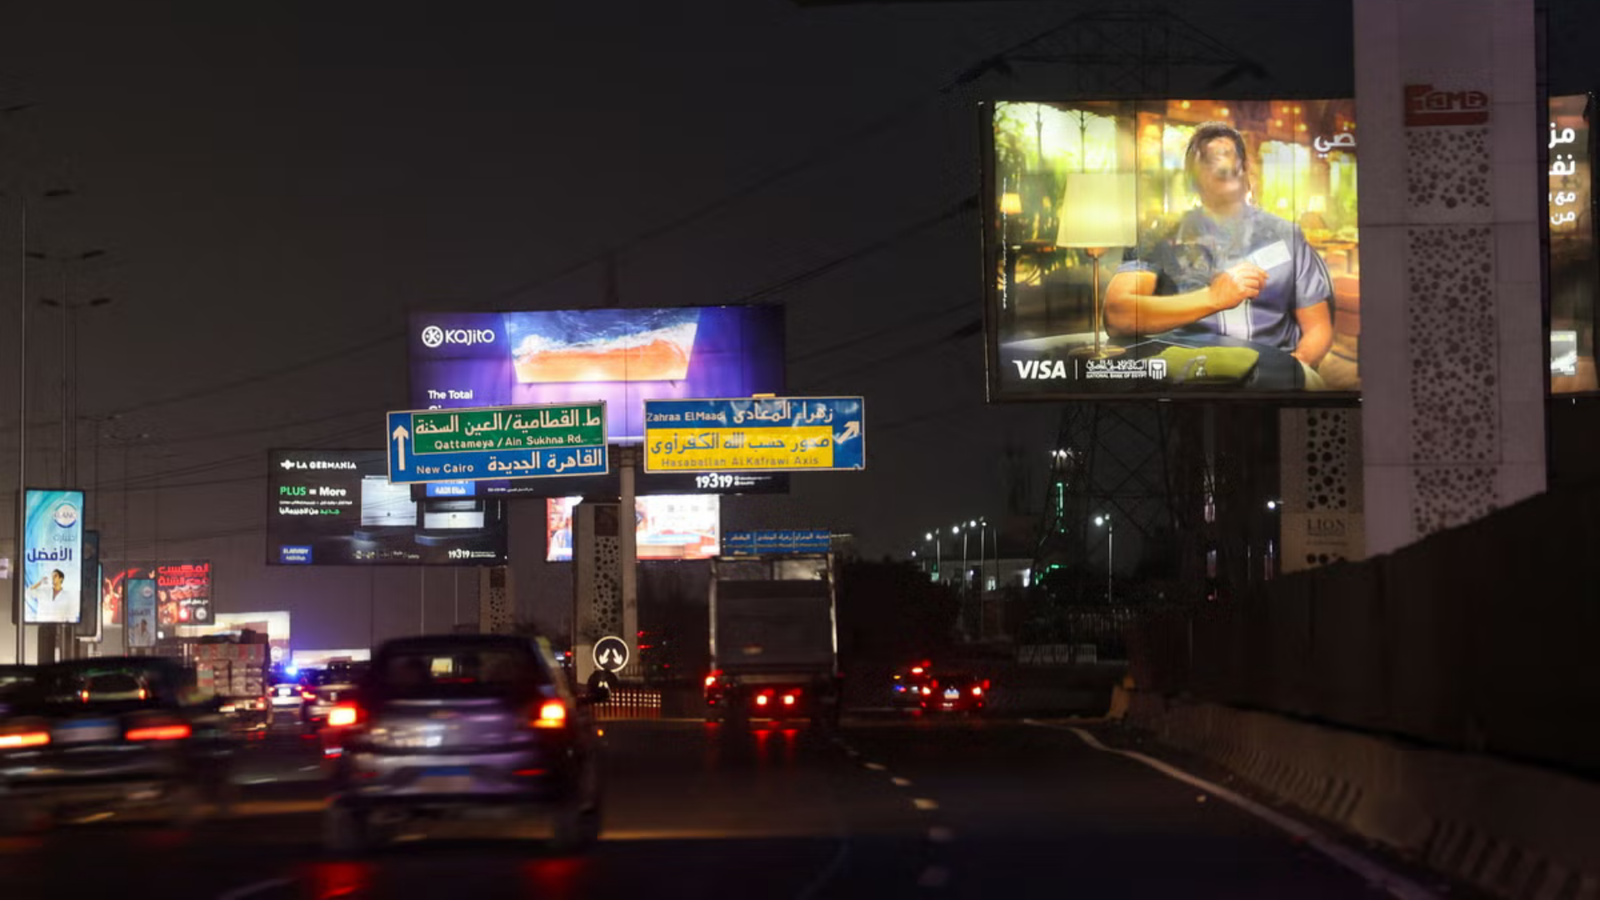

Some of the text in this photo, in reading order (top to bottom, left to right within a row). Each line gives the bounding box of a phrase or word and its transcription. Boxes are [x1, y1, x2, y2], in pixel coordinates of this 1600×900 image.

[1548, 154, 1576, 175] نف
[1012, 360, 1067, 380] VISA
[428, 389, 473, 400] The Total
[415, 414, 460, 435] السخنة
[647, 411, 681, 423] Zahraa
[434, 439, 494, 450] Qattameya
[505, 437, 522, 446] Ain
[526, 434, 563, 445] Sukhna
[568, 434, 584, 443] Rd.
[723, 432, 745, 449] الله
[748, 439, 785, 453] حسب
[790, 437, 830, 452] محور
[296, 461, 357, 469] LA GERMANIA
[487, 448, 603, 474] القاهرة الجديدة
[794, 456, 819, 465] Axis
[416, 463, 474, 474] New Cairo
[695, 472, 733, 488] 19319
[279, 486, 307, 496] PLUS
[319, 486, 347, 497] More
[27, 546, 73, 563] الأفضل
[448, 548, 470, 559] 19319
